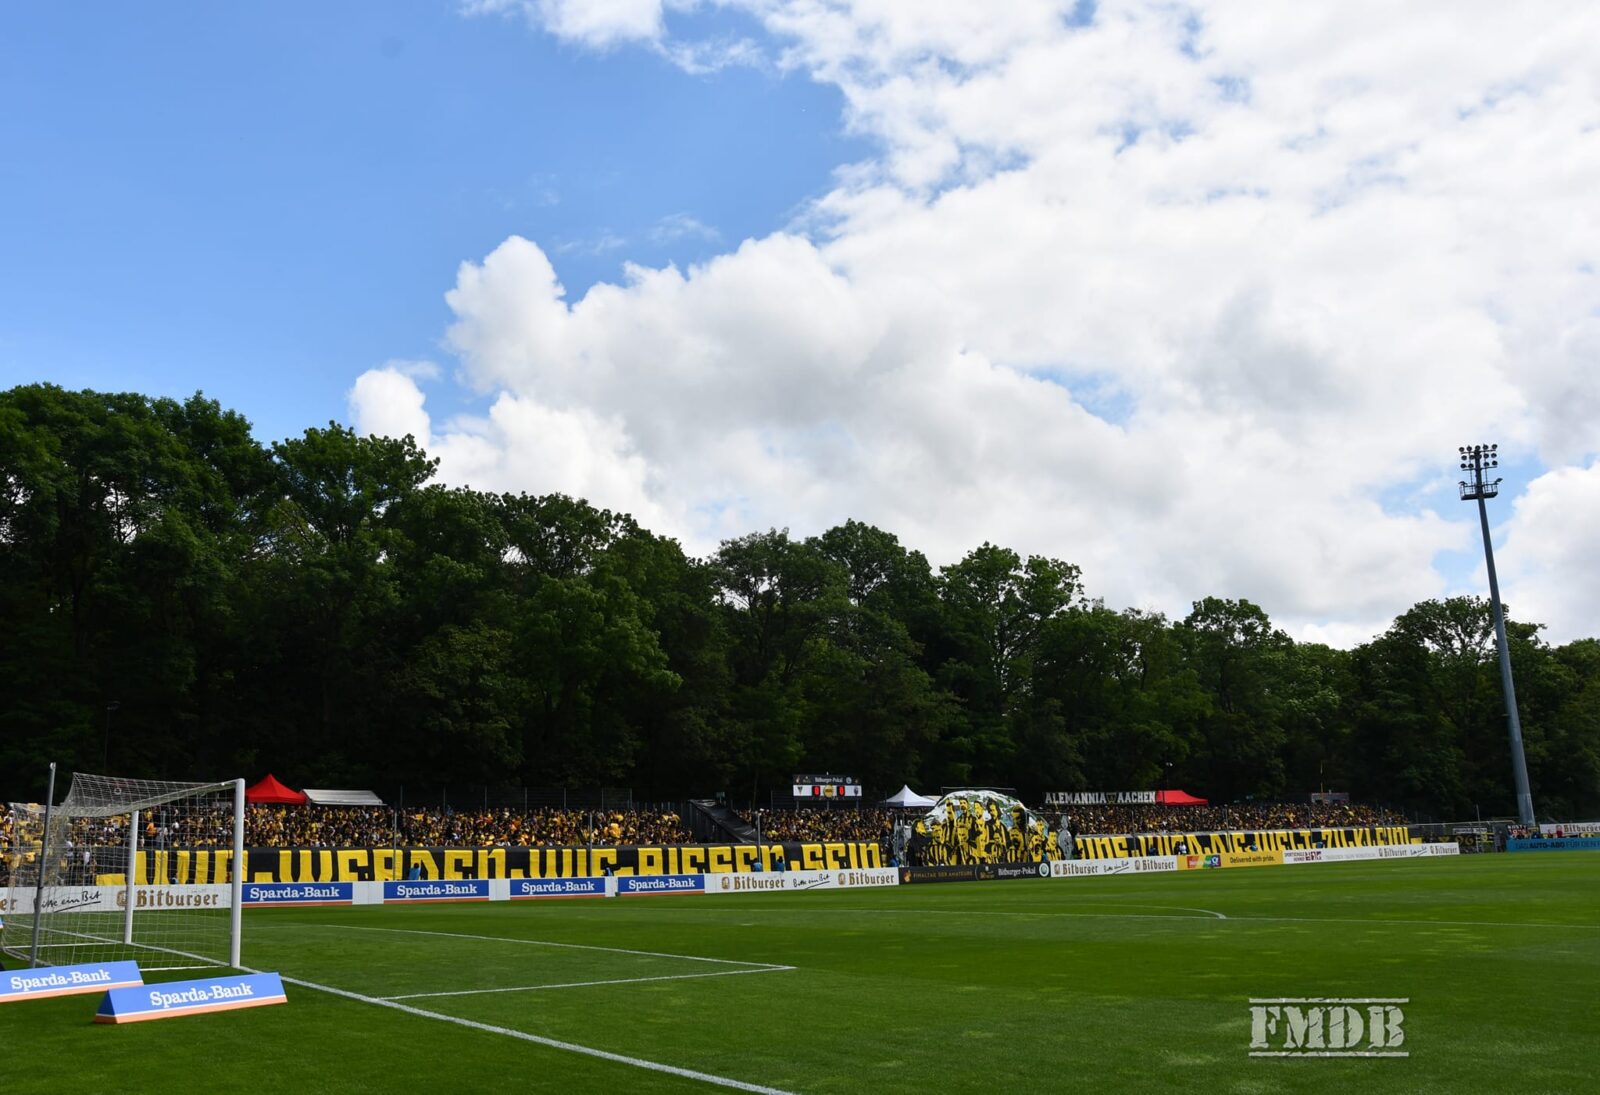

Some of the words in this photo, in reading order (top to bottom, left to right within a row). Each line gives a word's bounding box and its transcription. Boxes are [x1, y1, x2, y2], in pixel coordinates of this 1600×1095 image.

[1045, 792, 1106, 804] ALEMANNIA
[1117, 791, 1156, 803] AACHEN
[998, 866, 1036, 876] Bitburger-Pokal
[1063, 863, 1098, 874] Bitburger
[1142, 860, 1174, 870] Bitburger
[629, 878, 695, 891] Sparda-Bank
[734, 876, 785, 890] Bitburger
[850, 872, 895, 887] Bitburger
[250, 886, 339, 901] Sparda-Bank
[397, 884, 477, 897] Sparda-Bank
[522, 881, 595, 894] Sparda-Bank
[82, 891, 102, 901] Bit
[136, 890, 219, 907] Bitburger
[11, 970, 111, 991] Sparda-Bank
[150, 983, 253, 1008] Sparda-Bank
